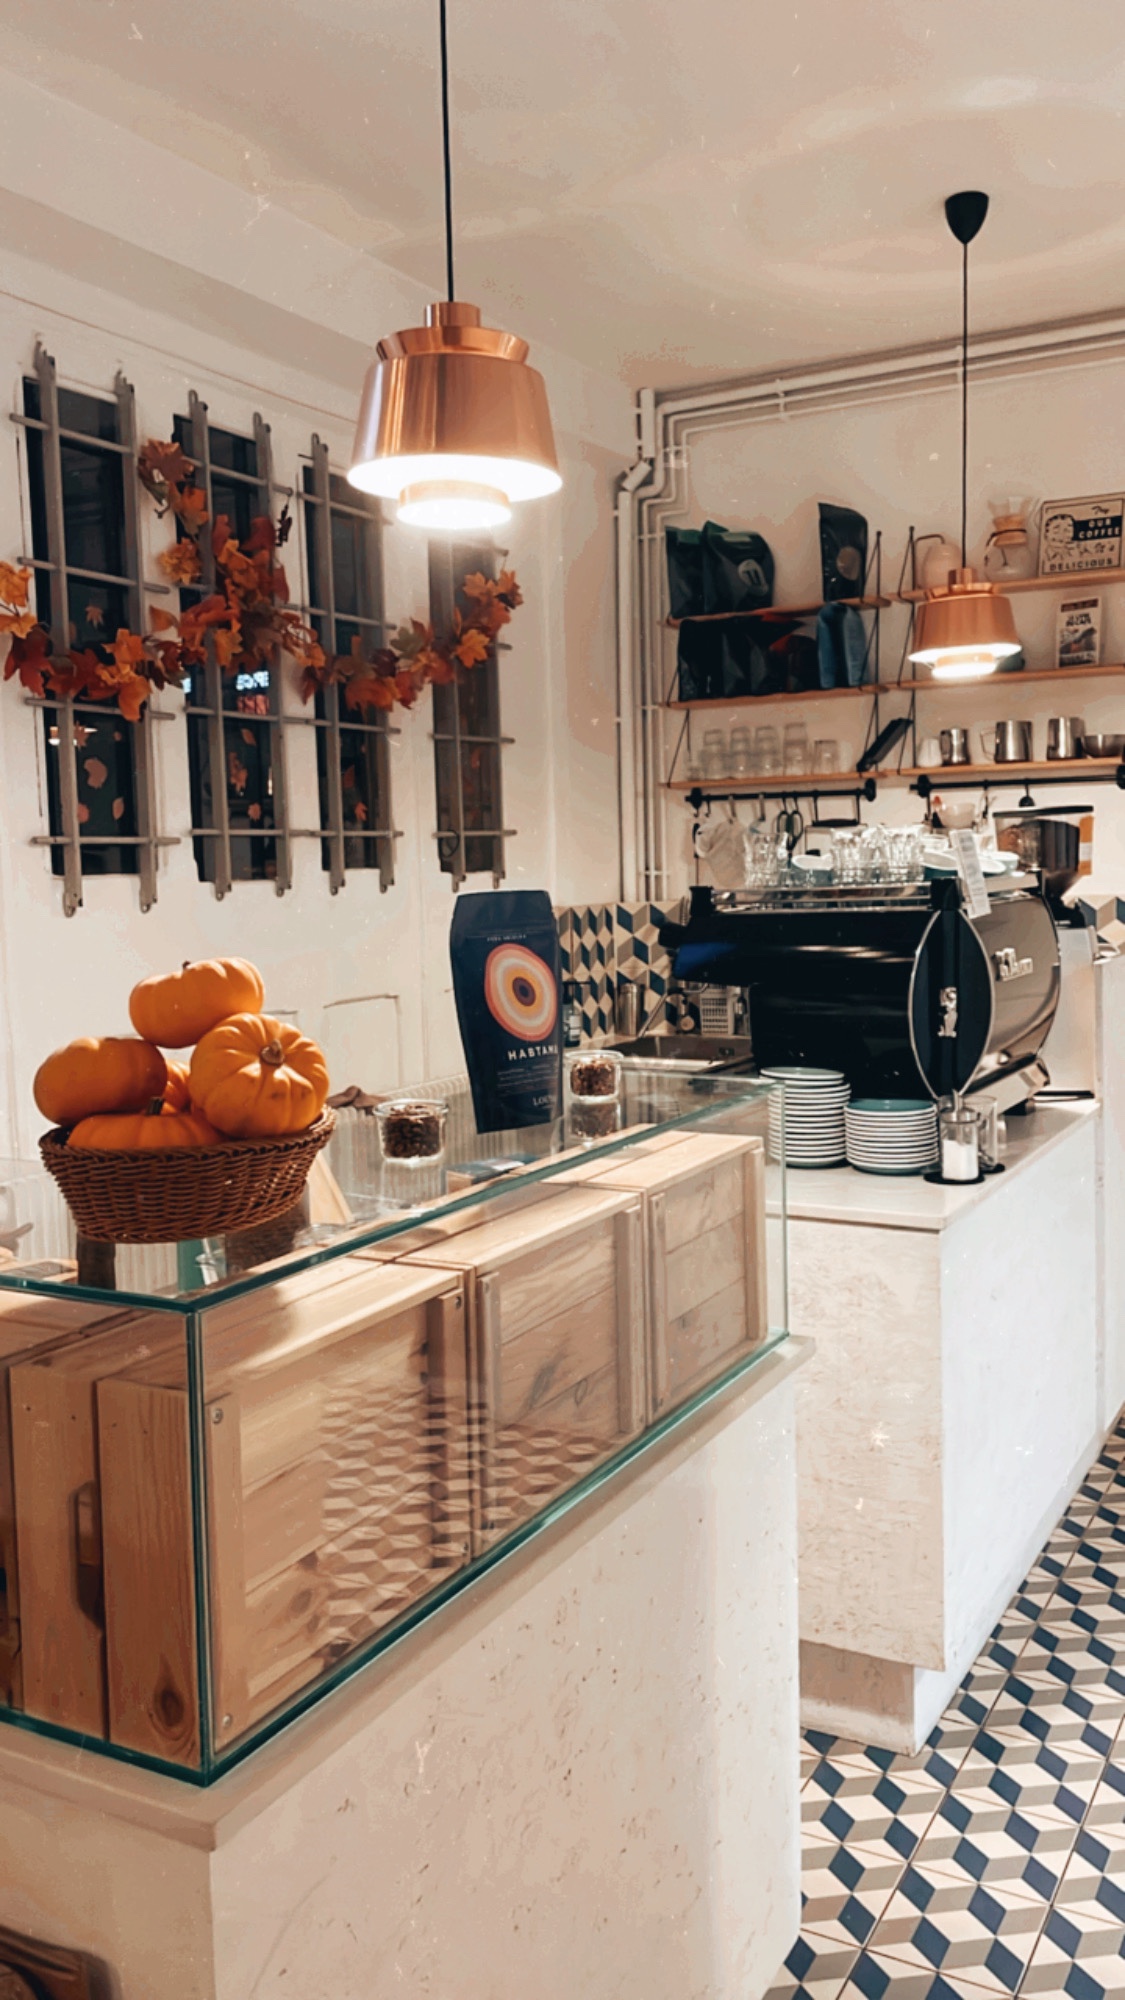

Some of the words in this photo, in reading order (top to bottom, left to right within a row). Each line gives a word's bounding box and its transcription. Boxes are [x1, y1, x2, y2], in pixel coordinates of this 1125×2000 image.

[1089, 518, 1111, 528] OUR
[1079, 527, 1121, 539] COFFEE
[1050, 558, 1112, 571] DELICIOUS
